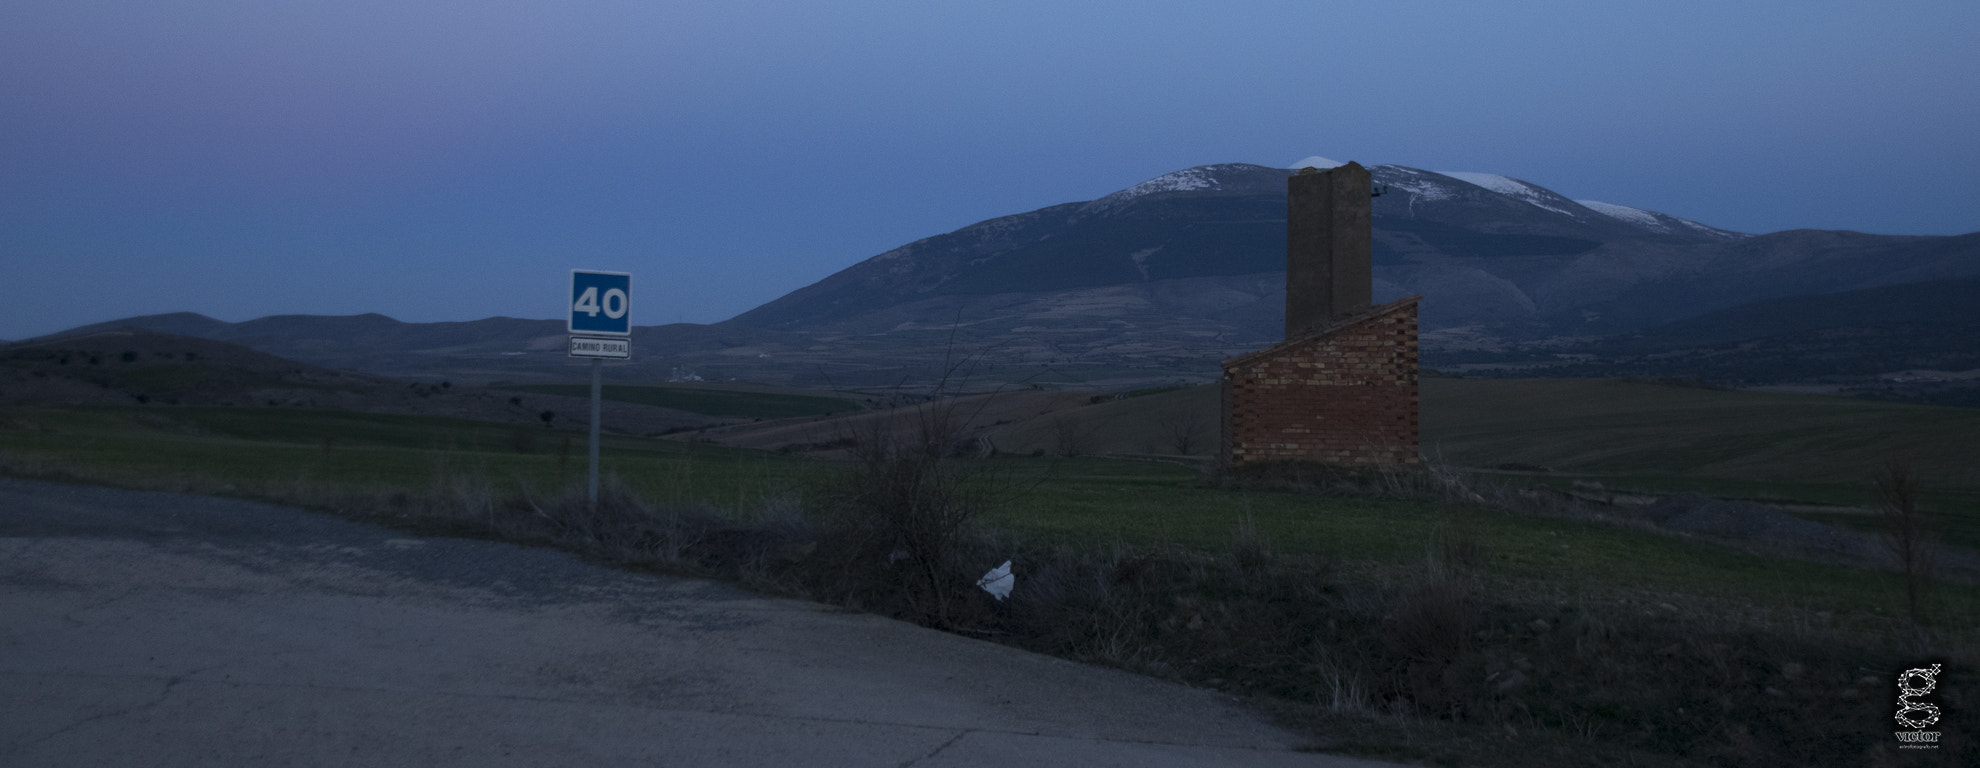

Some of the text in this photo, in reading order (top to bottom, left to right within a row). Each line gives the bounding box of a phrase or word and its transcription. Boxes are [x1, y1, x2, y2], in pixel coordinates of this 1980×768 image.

[574, 286, 628, 319] 40
[572, 341, 628, 353] CAMINO RURAL
